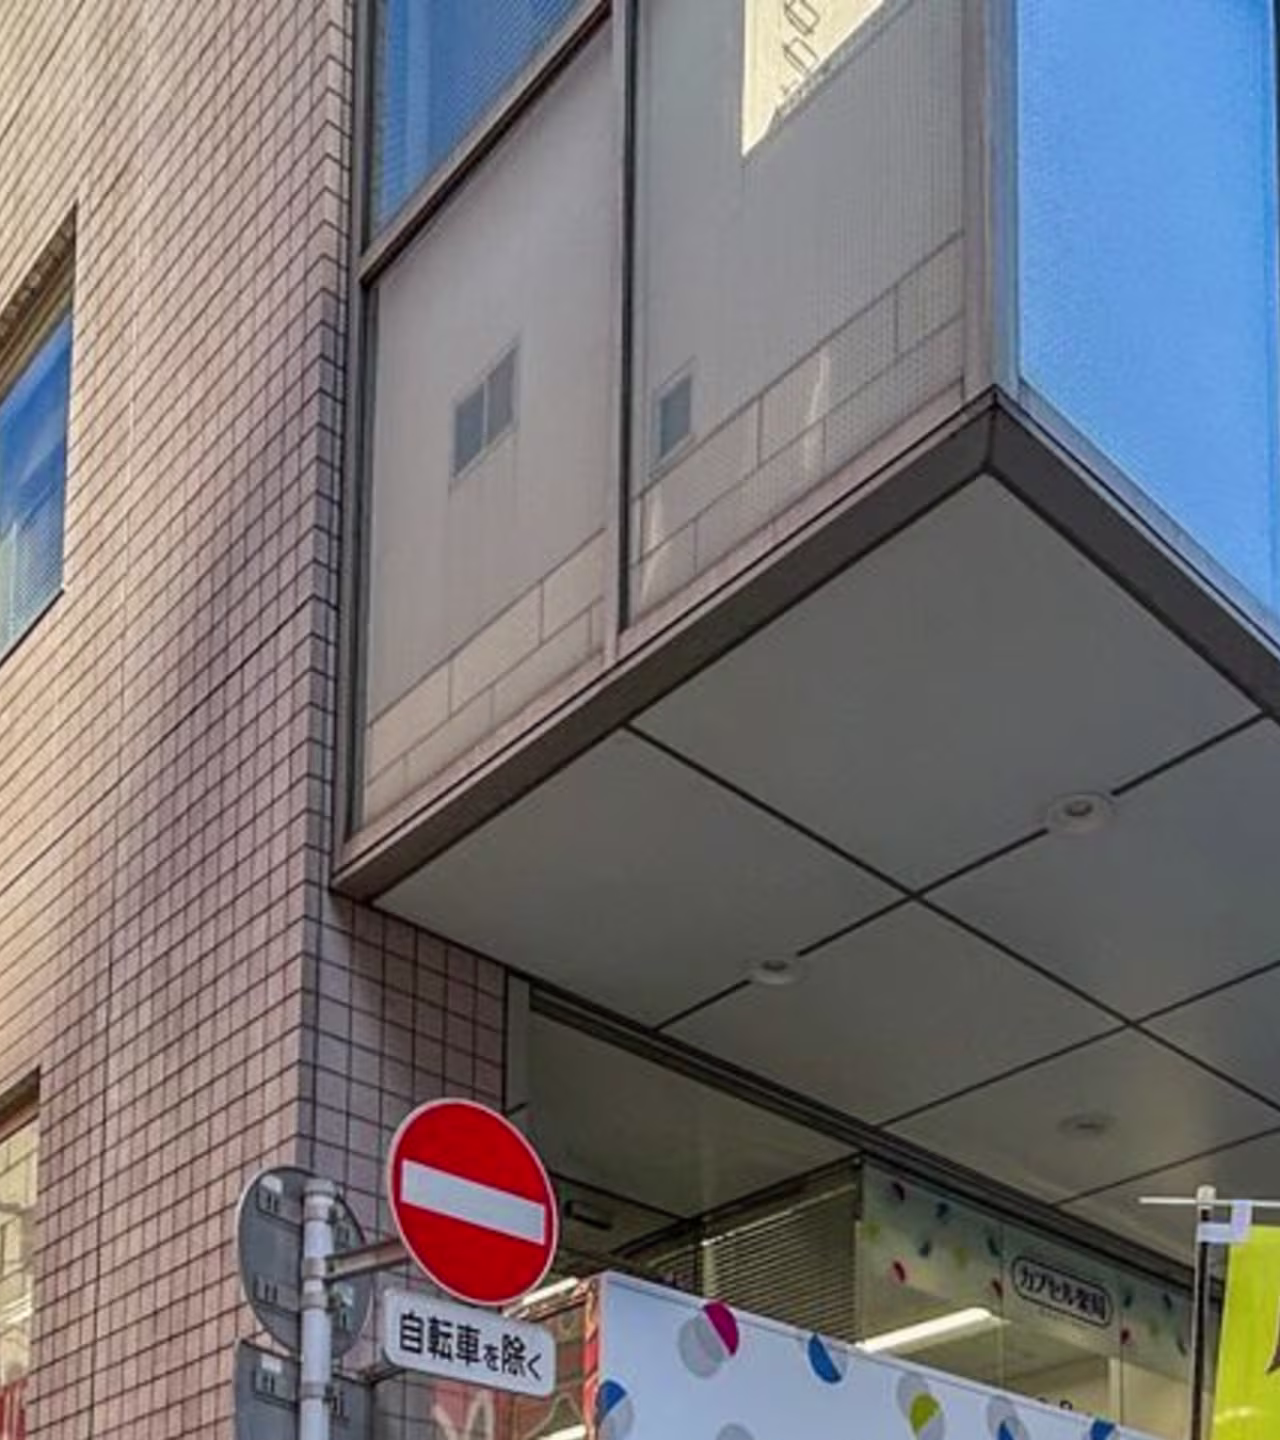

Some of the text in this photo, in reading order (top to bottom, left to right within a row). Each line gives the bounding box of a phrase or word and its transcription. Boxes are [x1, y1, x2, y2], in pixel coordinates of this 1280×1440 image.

[399, 1308, 543, 1382] 自転車を除く
